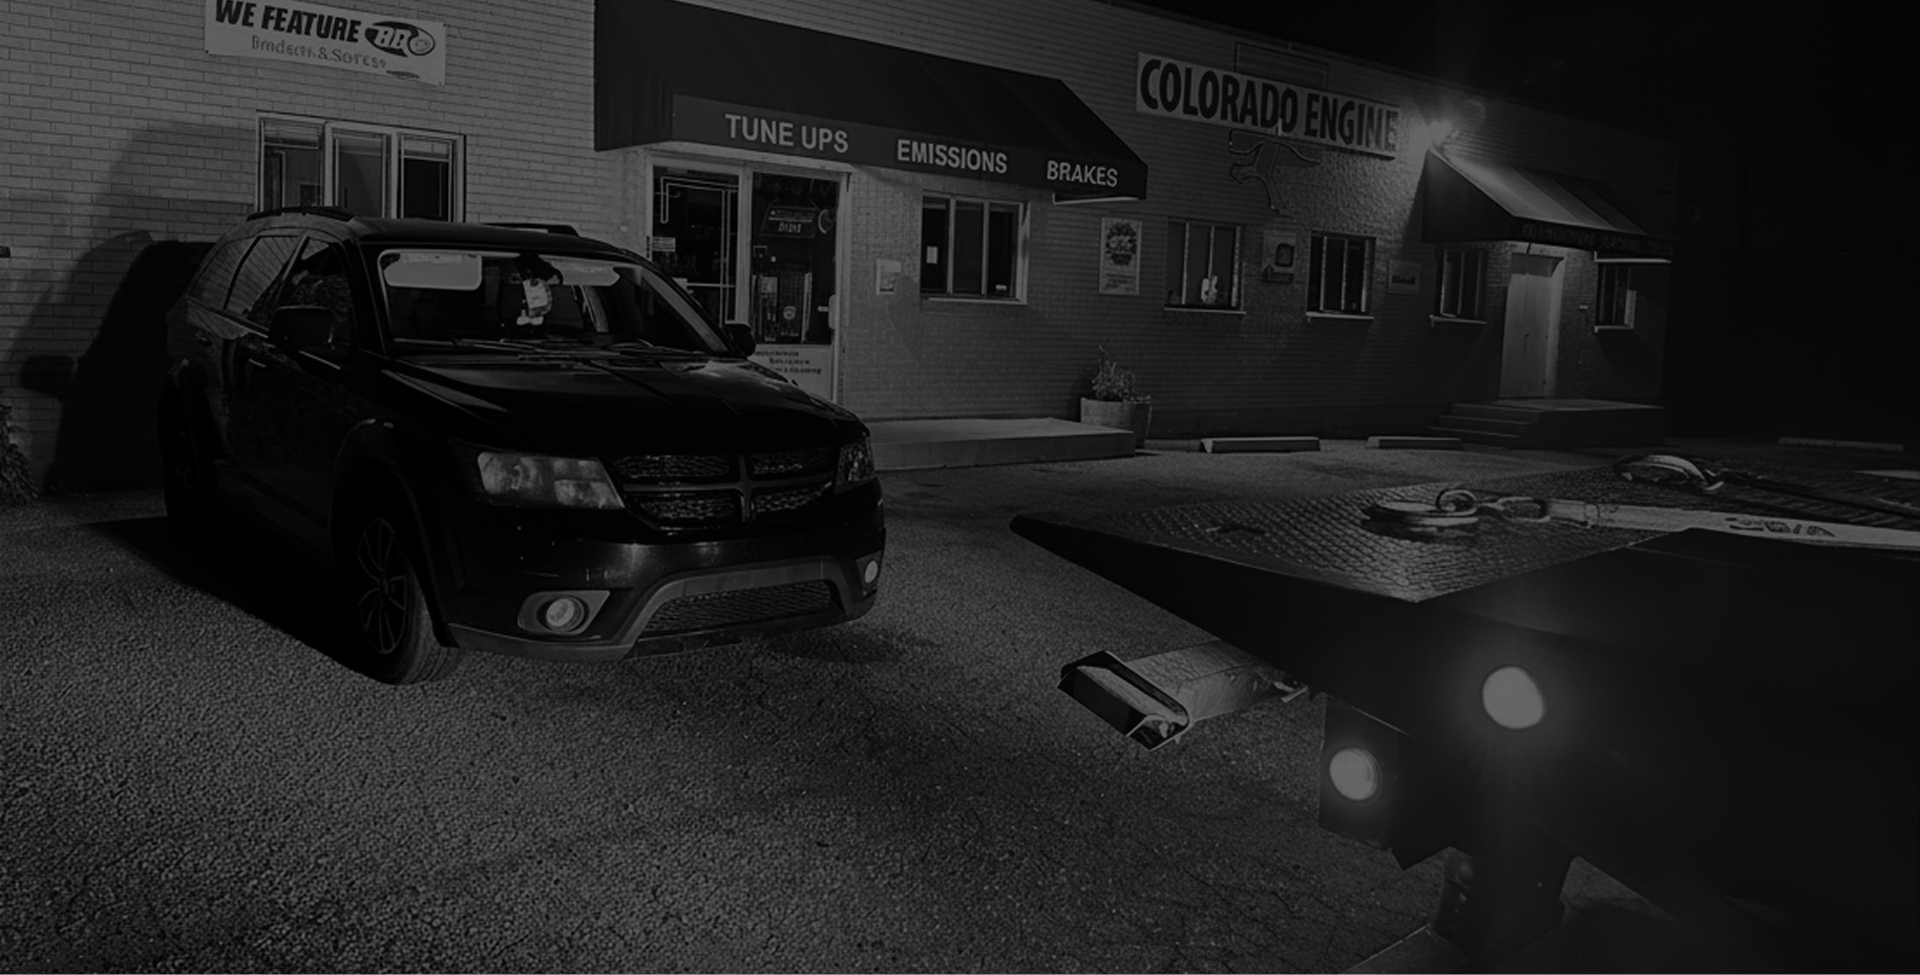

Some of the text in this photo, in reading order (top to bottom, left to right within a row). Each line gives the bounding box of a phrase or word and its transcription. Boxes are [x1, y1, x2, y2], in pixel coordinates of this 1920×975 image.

[215, 0, 254, 27] WE
[261, 6, 361, 42] FEATURE
[1140, 59, 1399, 151] COLORADO ENGINE
[725, 113, 1118, 188] TUNE UPS EMISSIONS BRAKES
